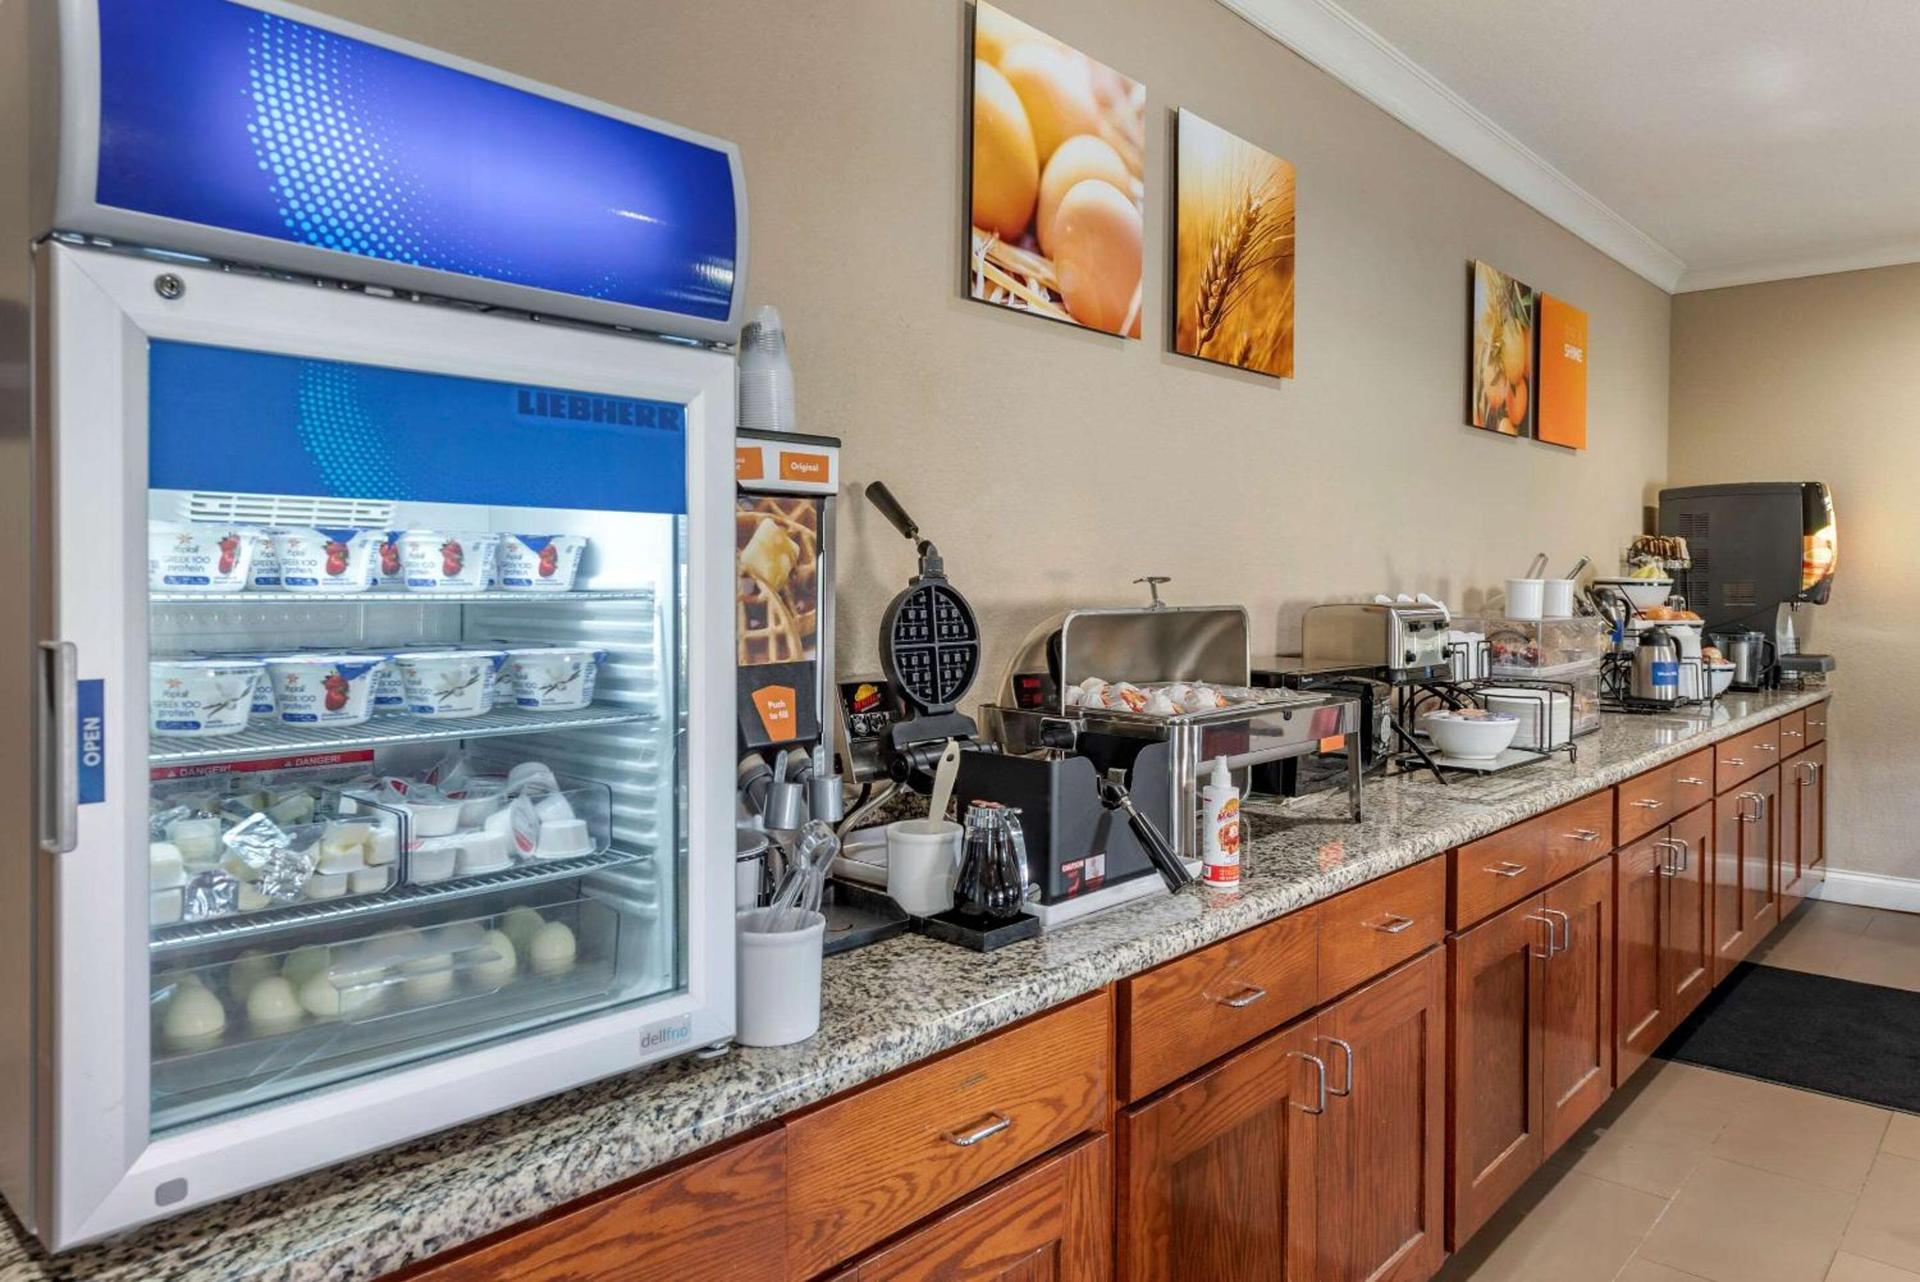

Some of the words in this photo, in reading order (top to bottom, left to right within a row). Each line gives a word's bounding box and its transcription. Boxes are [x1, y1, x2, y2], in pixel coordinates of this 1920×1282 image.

[517, 389, 681, 432] LIEBHERR
[790, 461, 819, 473] Original
[767, 699, 787, 709] Push
[83, 717, 101, 767] OPEN
[180, 763, 231, 777] DANGER!
[296, 754, 341, 766] DANGER!
